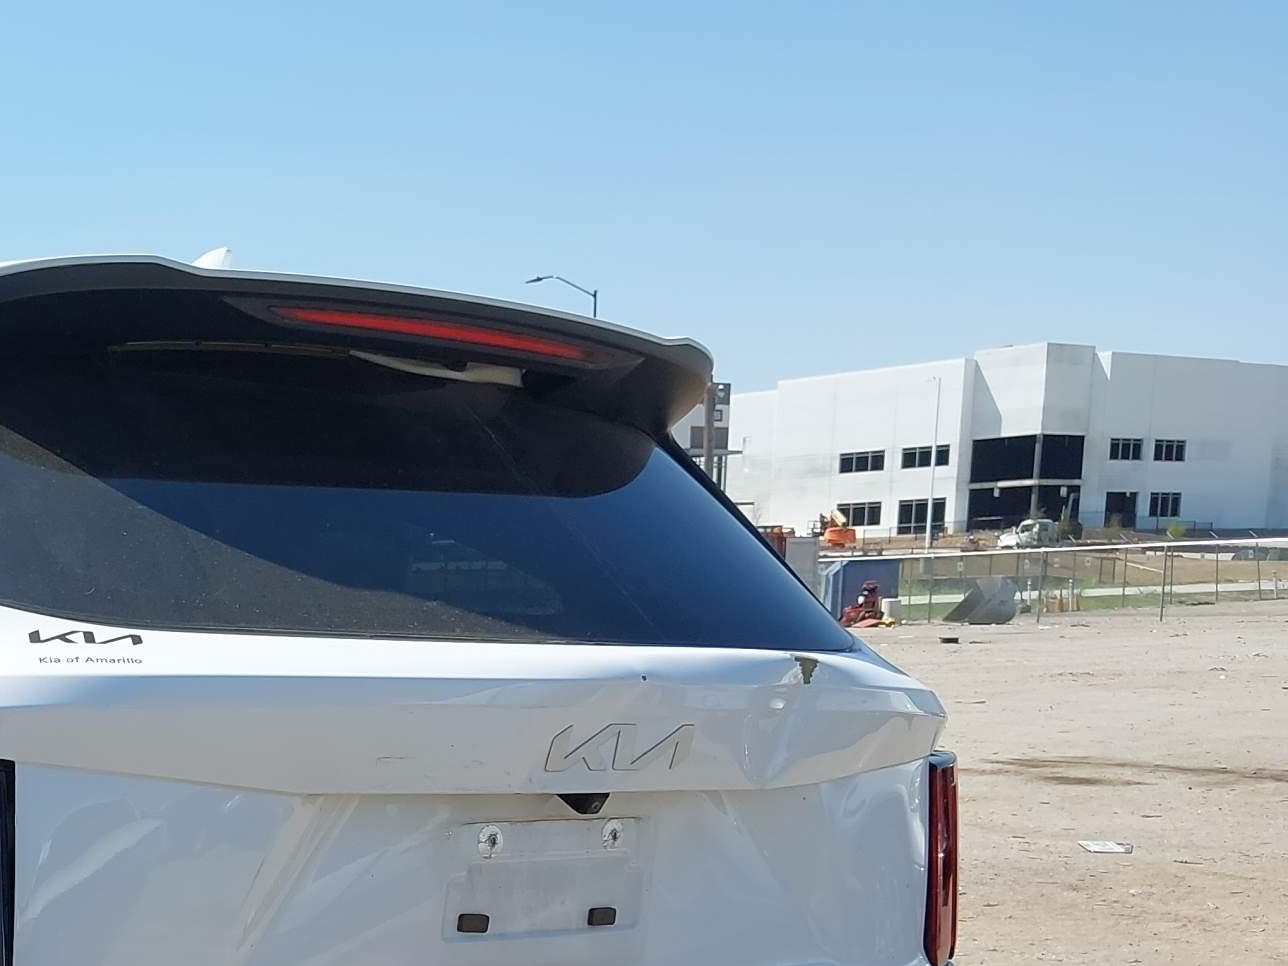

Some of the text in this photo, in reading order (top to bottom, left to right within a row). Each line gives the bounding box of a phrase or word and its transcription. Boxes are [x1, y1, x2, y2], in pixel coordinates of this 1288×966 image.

[28, 630, 143, 645] KIA
[85, 656, 143, 664] Amarillo
[544, 723, 695, 772] KIA
